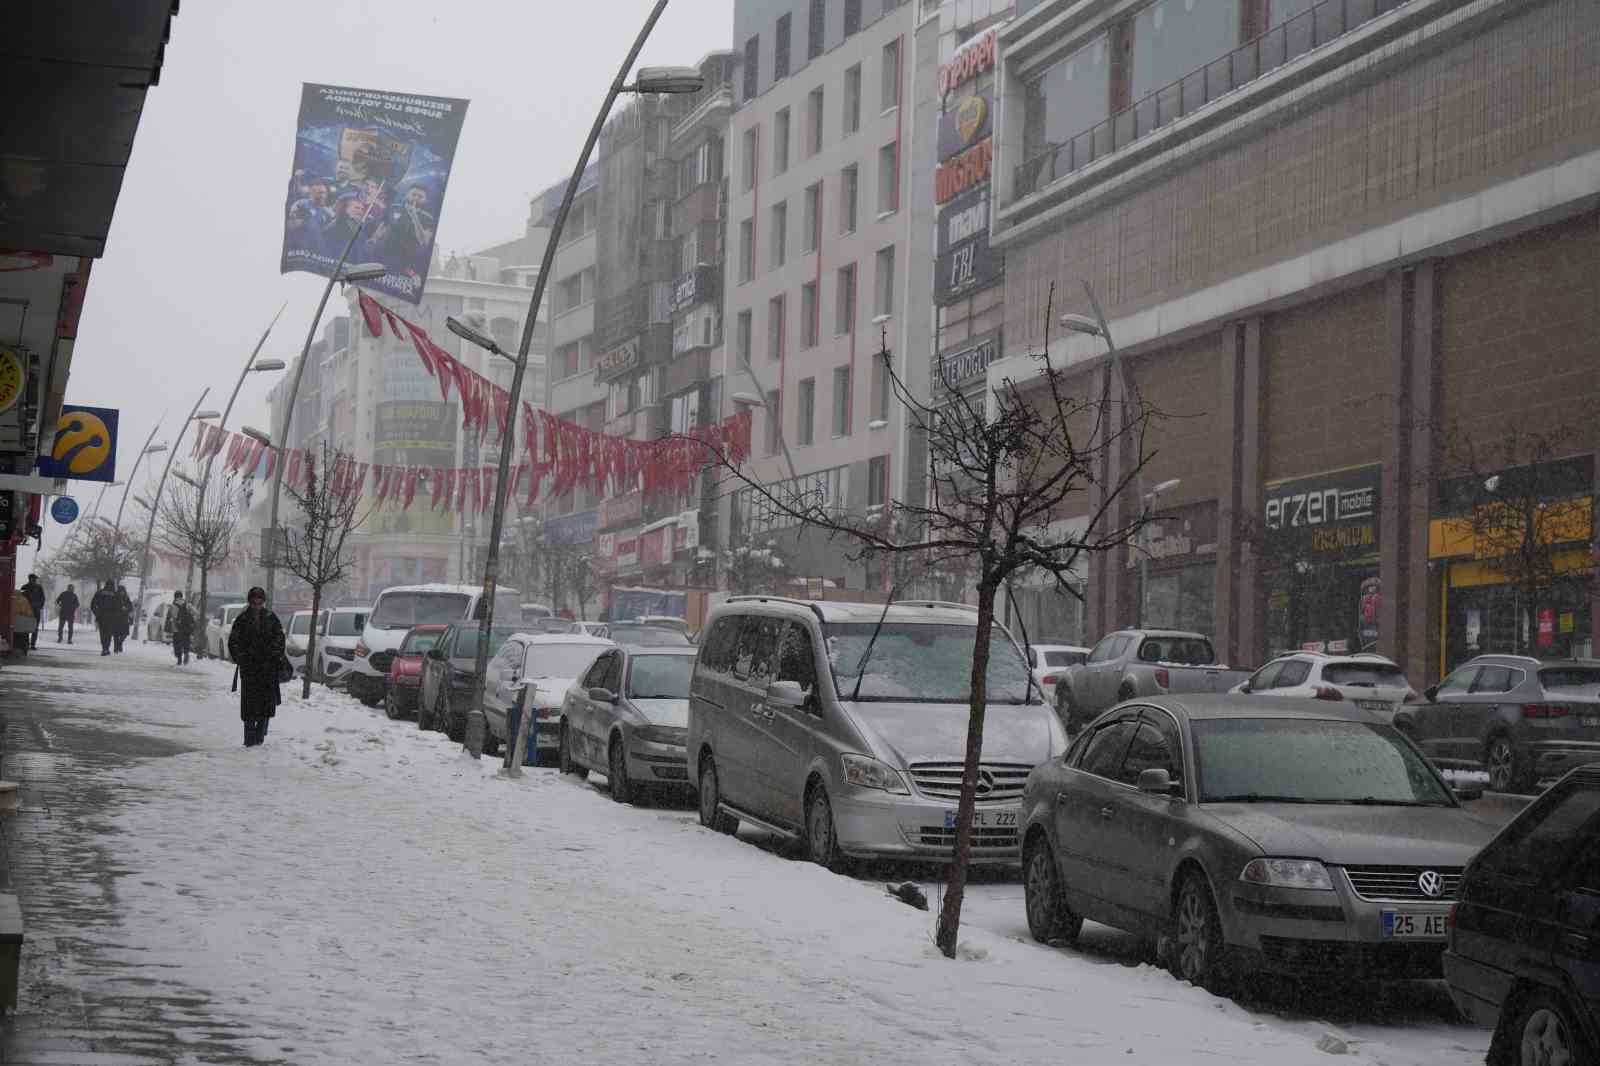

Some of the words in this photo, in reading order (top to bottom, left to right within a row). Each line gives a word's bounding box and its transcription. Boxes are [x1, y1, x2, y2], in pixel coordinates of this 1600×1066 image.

[949, 191, 987, 245] mavi
[1265, 488, 1339, 530] erzen
[996, 812, 1017, 825] 222
[1394, 915, 1414, 934] 25
